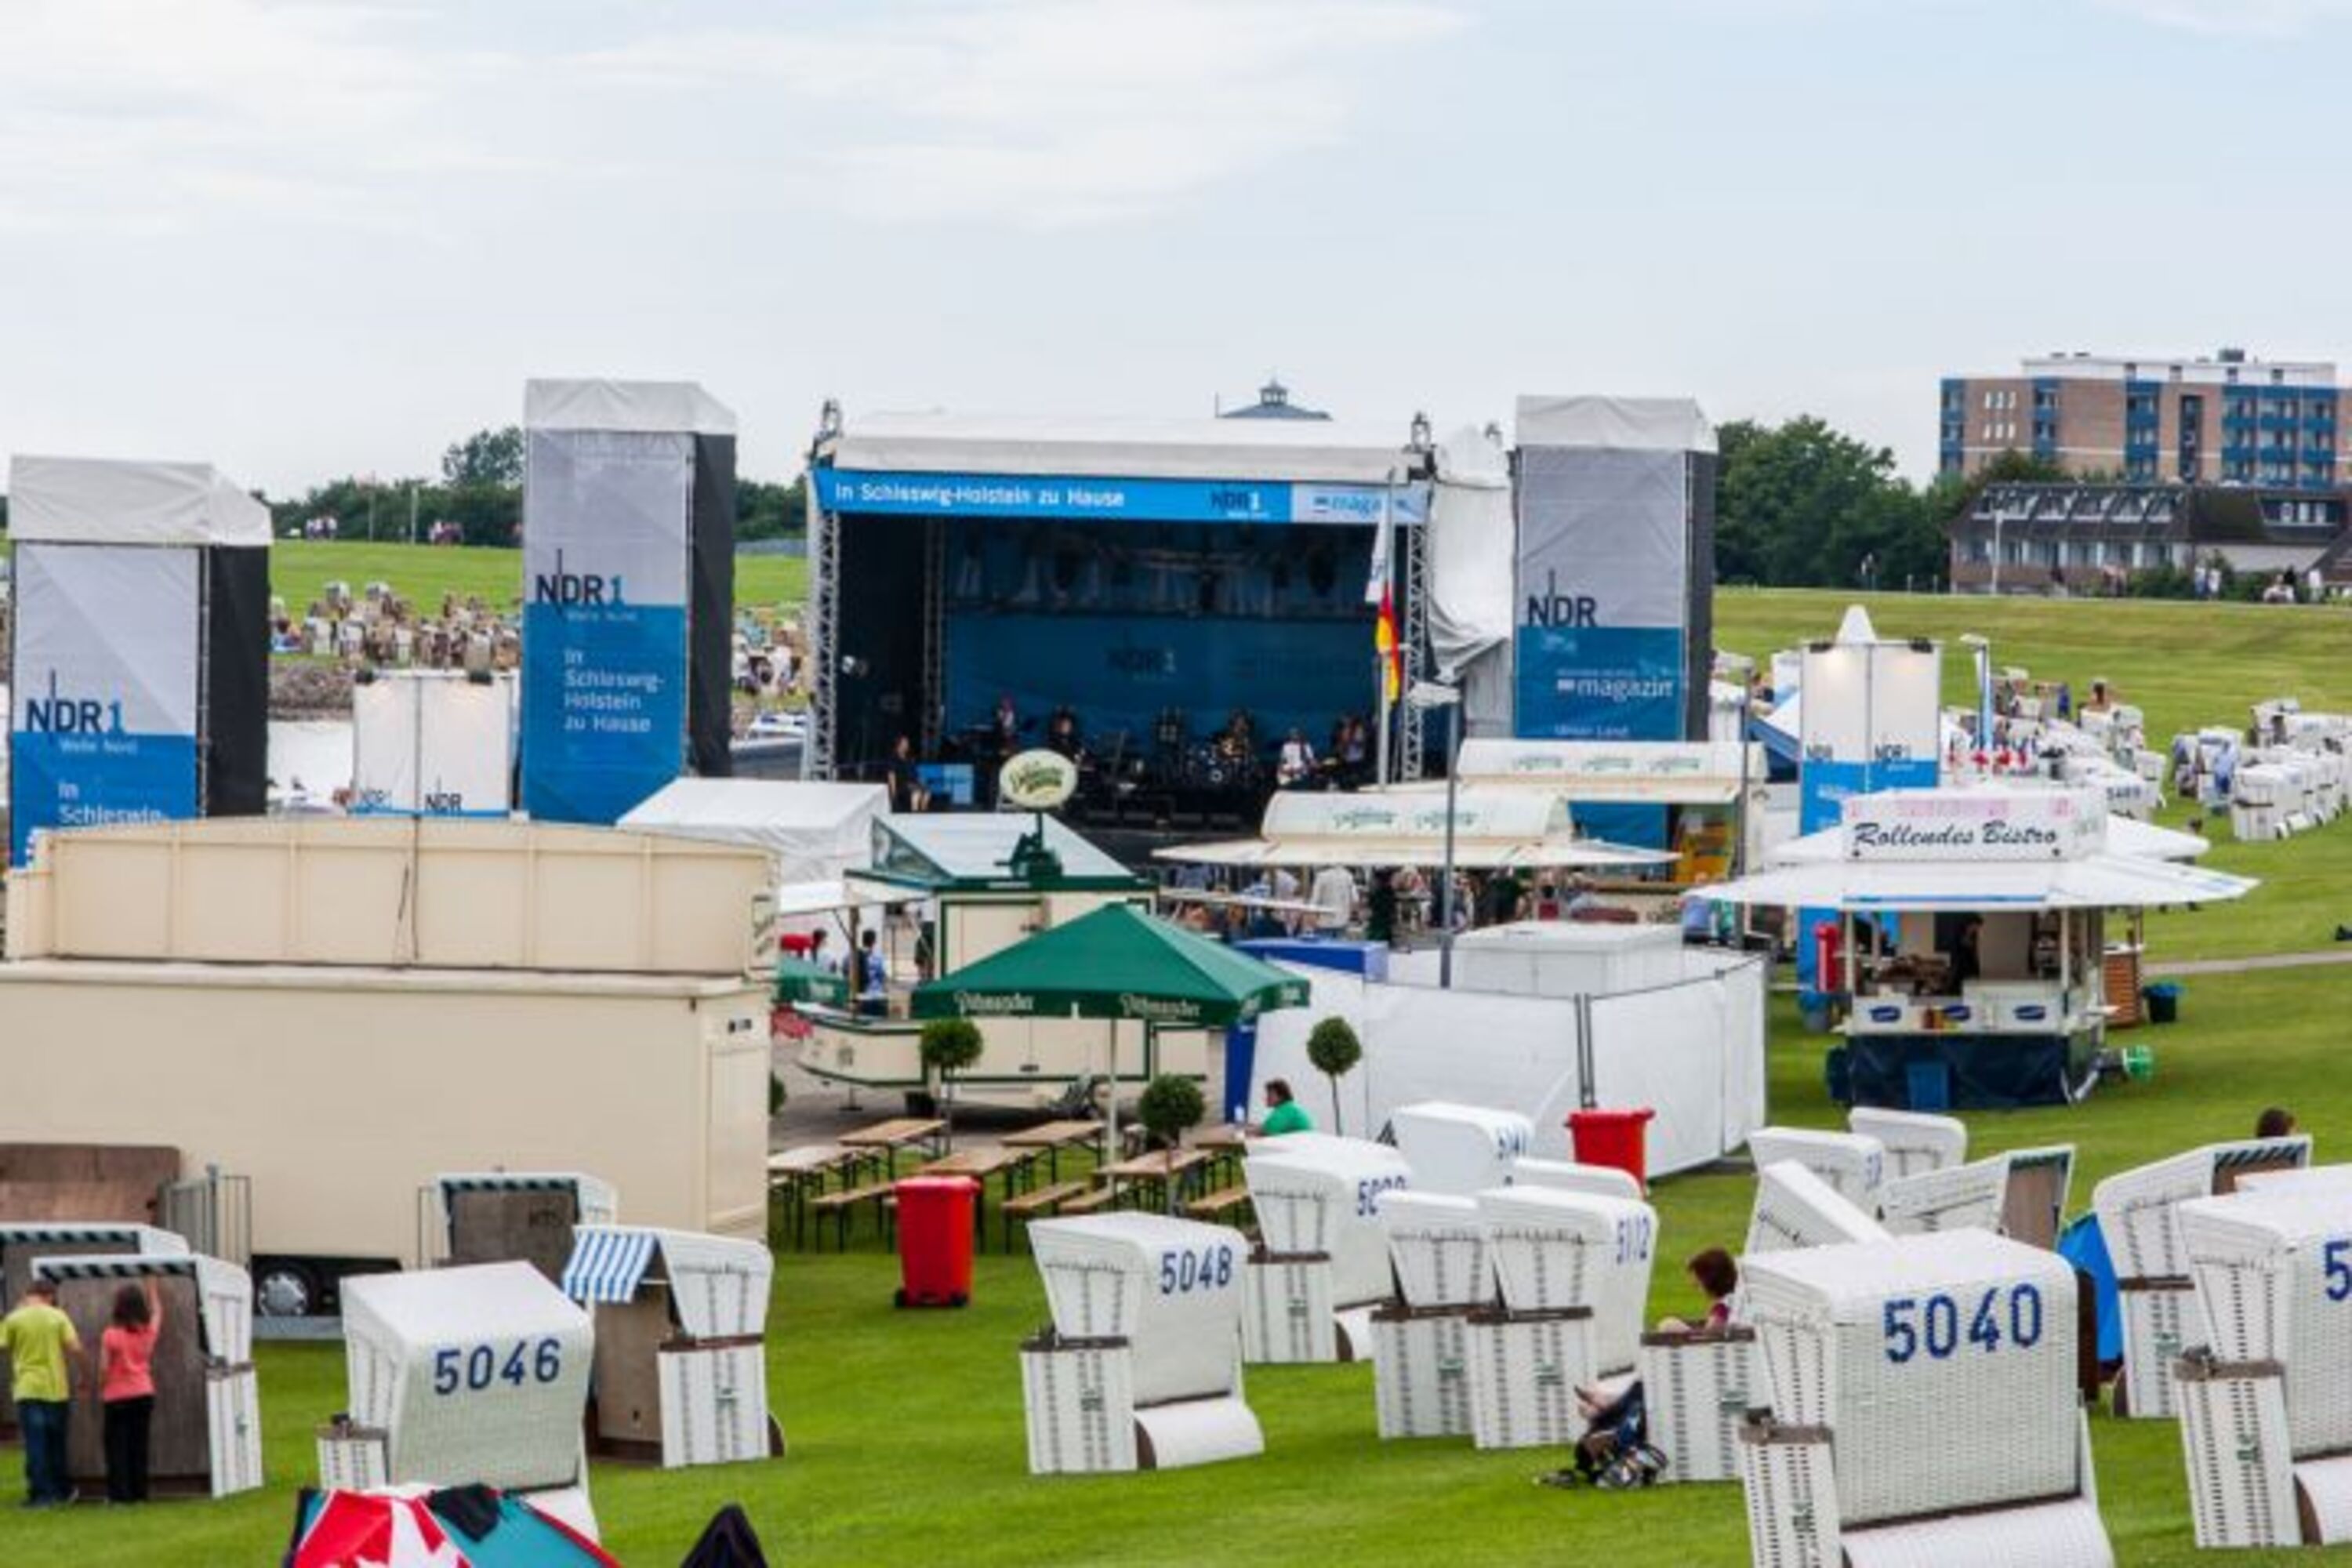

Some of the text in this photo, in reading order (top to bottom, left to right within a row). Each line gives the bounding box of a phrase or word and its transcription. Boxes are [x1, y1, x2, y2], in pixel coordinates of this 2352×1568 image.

[835, 483, 853, 502] In
[1038, 489, 1058, 505] zu
[1068, 488, 1124, 506] Hause
[1529, 596, 1597, 627] NDR
[564, 648, 583, 663] In
[564, 692, 641, 710] Holstein
[1577, 674, 1673, 702] magazin
[594, 715, 651, 732] Hause
[1853, 820, 2056, 845] Rollendes Bistro
[1161, 1244, 1232, 1294] 5048
[1884, 1283, 2042, 1363] 5040
[434, 1337, 560, 1396] 5046
